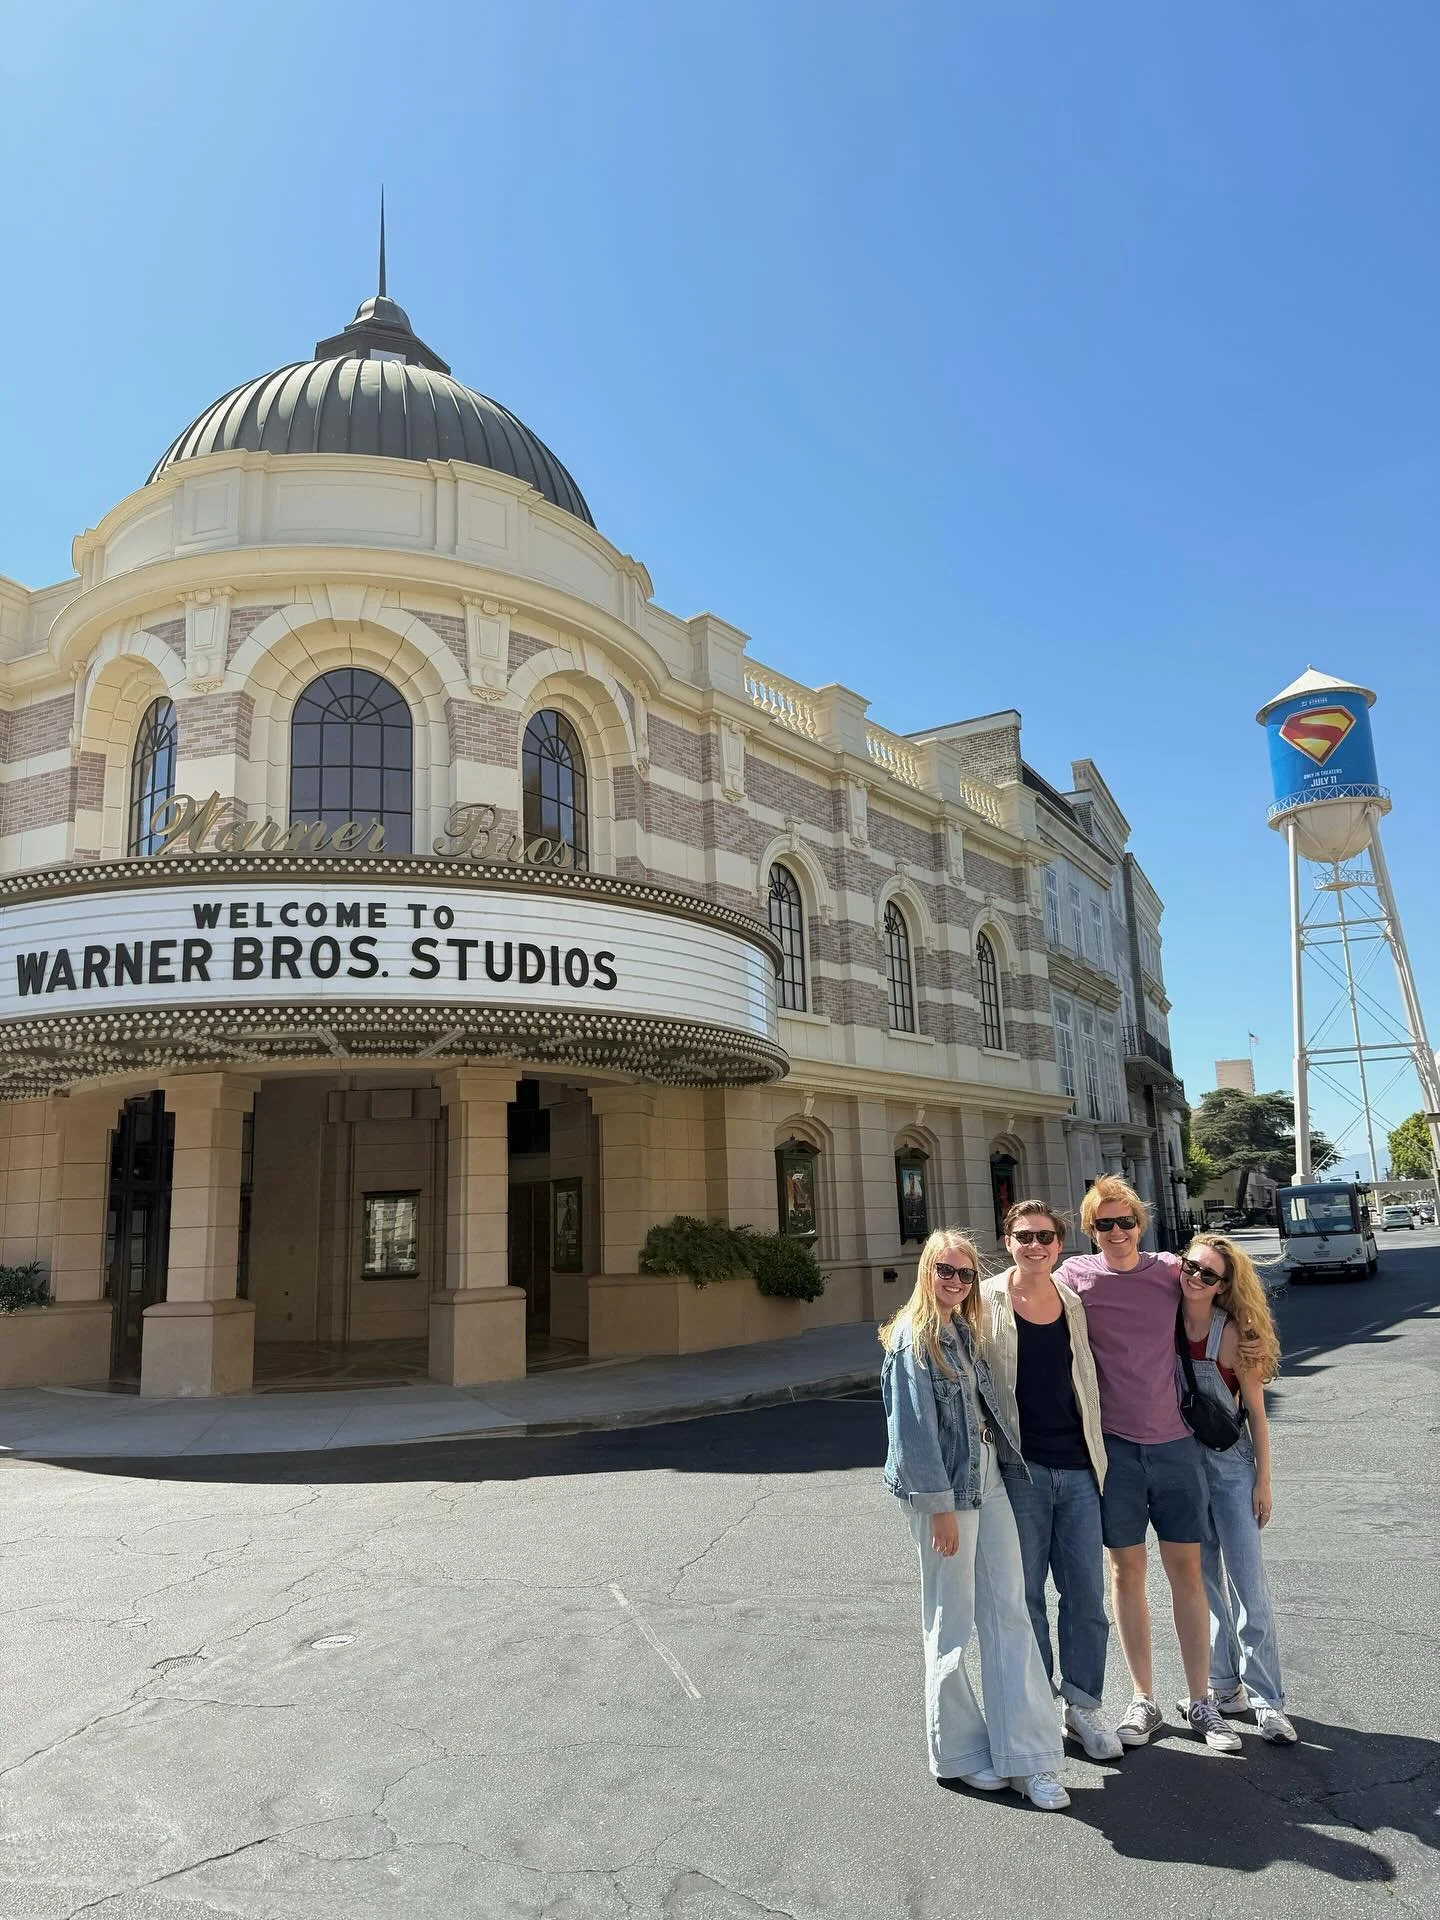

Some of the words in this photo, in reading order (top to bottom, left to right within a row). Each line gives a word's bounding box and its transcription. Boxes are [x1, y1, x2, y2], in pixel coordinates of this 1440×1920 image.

[1310, 776, 1329, 787] JULY
[1330, 775, 1337, 784] 11
[1320, 768, 1343, 776] THEATERS
[151, 790, 387, 856] Warner
[192, 902, 387, 930] WELCOME
[408, 903, 455, 930] TO
[16, 938, 213, 997] WARNER
[232, 935, 390, 981] BROS.
[409, 937, 618, 991] STUDIOS
